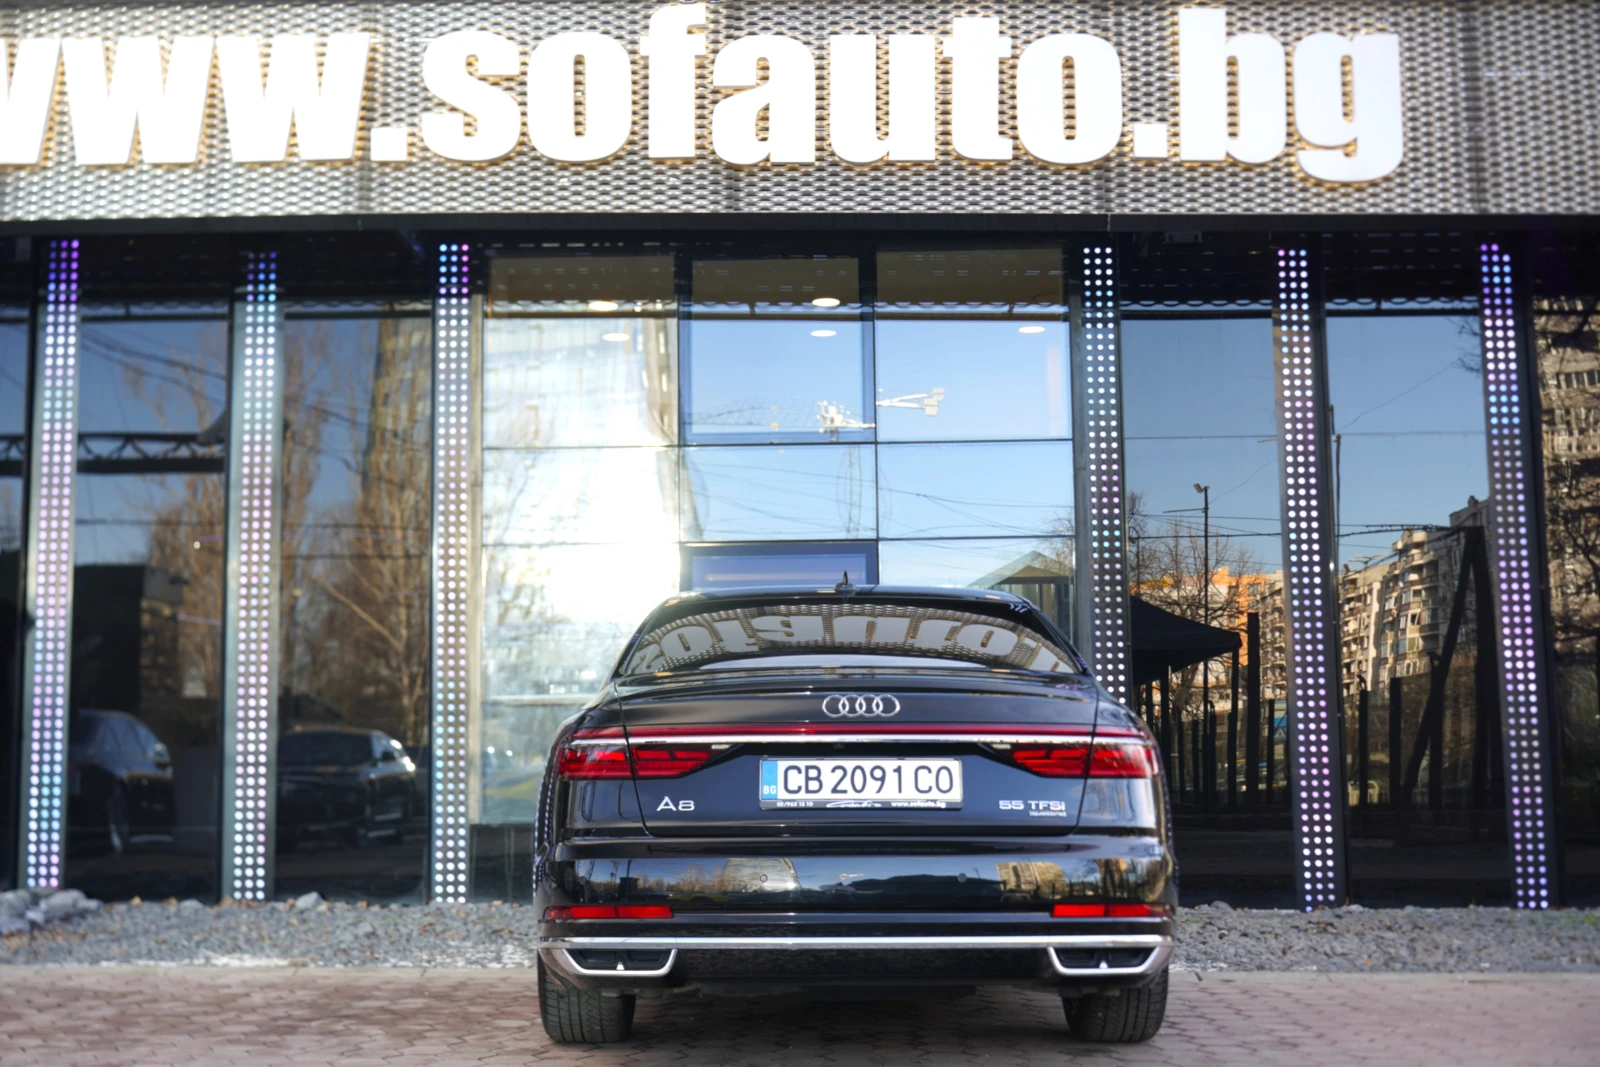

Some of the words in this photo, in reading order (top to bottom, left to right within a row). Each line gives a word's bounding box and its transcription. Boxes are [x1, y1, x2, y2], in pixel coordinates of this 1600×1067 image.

[830, 765, 903, 794] 2091
[763, 785, 777, 795] BG
[656, 795, 695, 812] A8
[998, 799, 1025, 810] 55
[1027, 800, 1066, 811] TFSI
